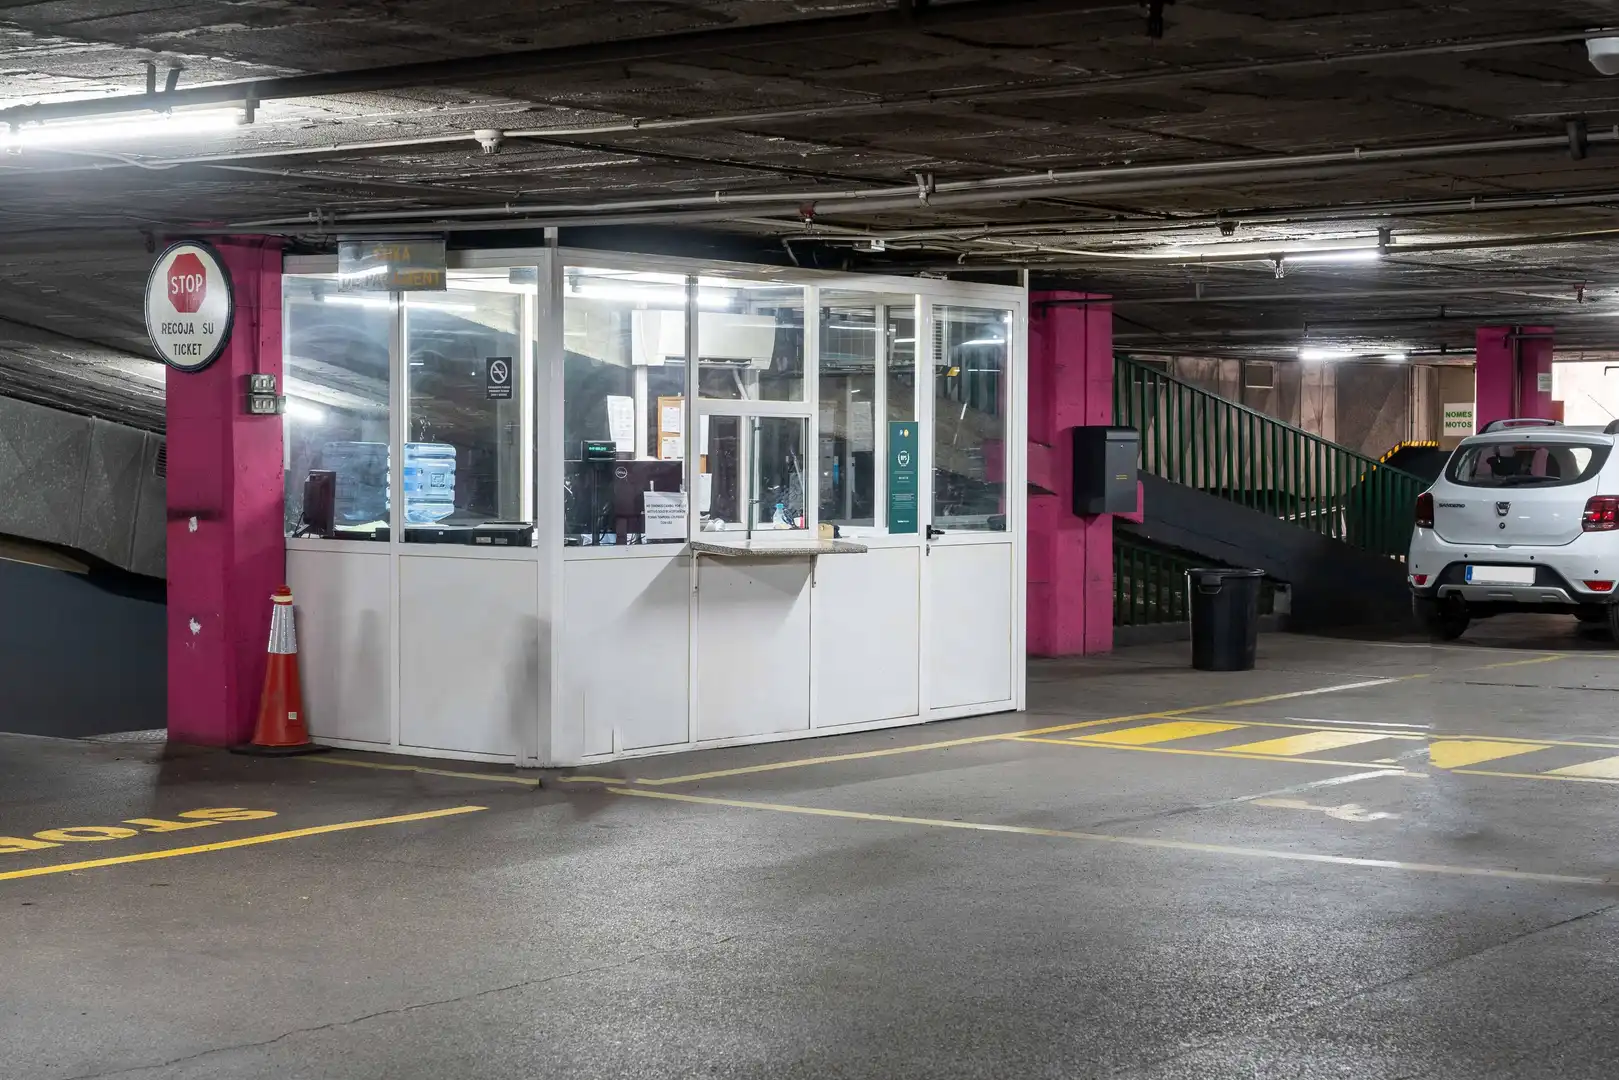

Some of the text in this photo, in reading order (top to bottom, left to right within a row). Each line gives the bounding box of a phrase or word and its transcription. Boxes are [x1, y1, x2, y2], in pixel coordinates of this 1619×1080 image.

[171, 274, 203, 295] STOP
[161, 322, 214, 335] RECOJA SU
[173, 343, 203, 356] TICKET
